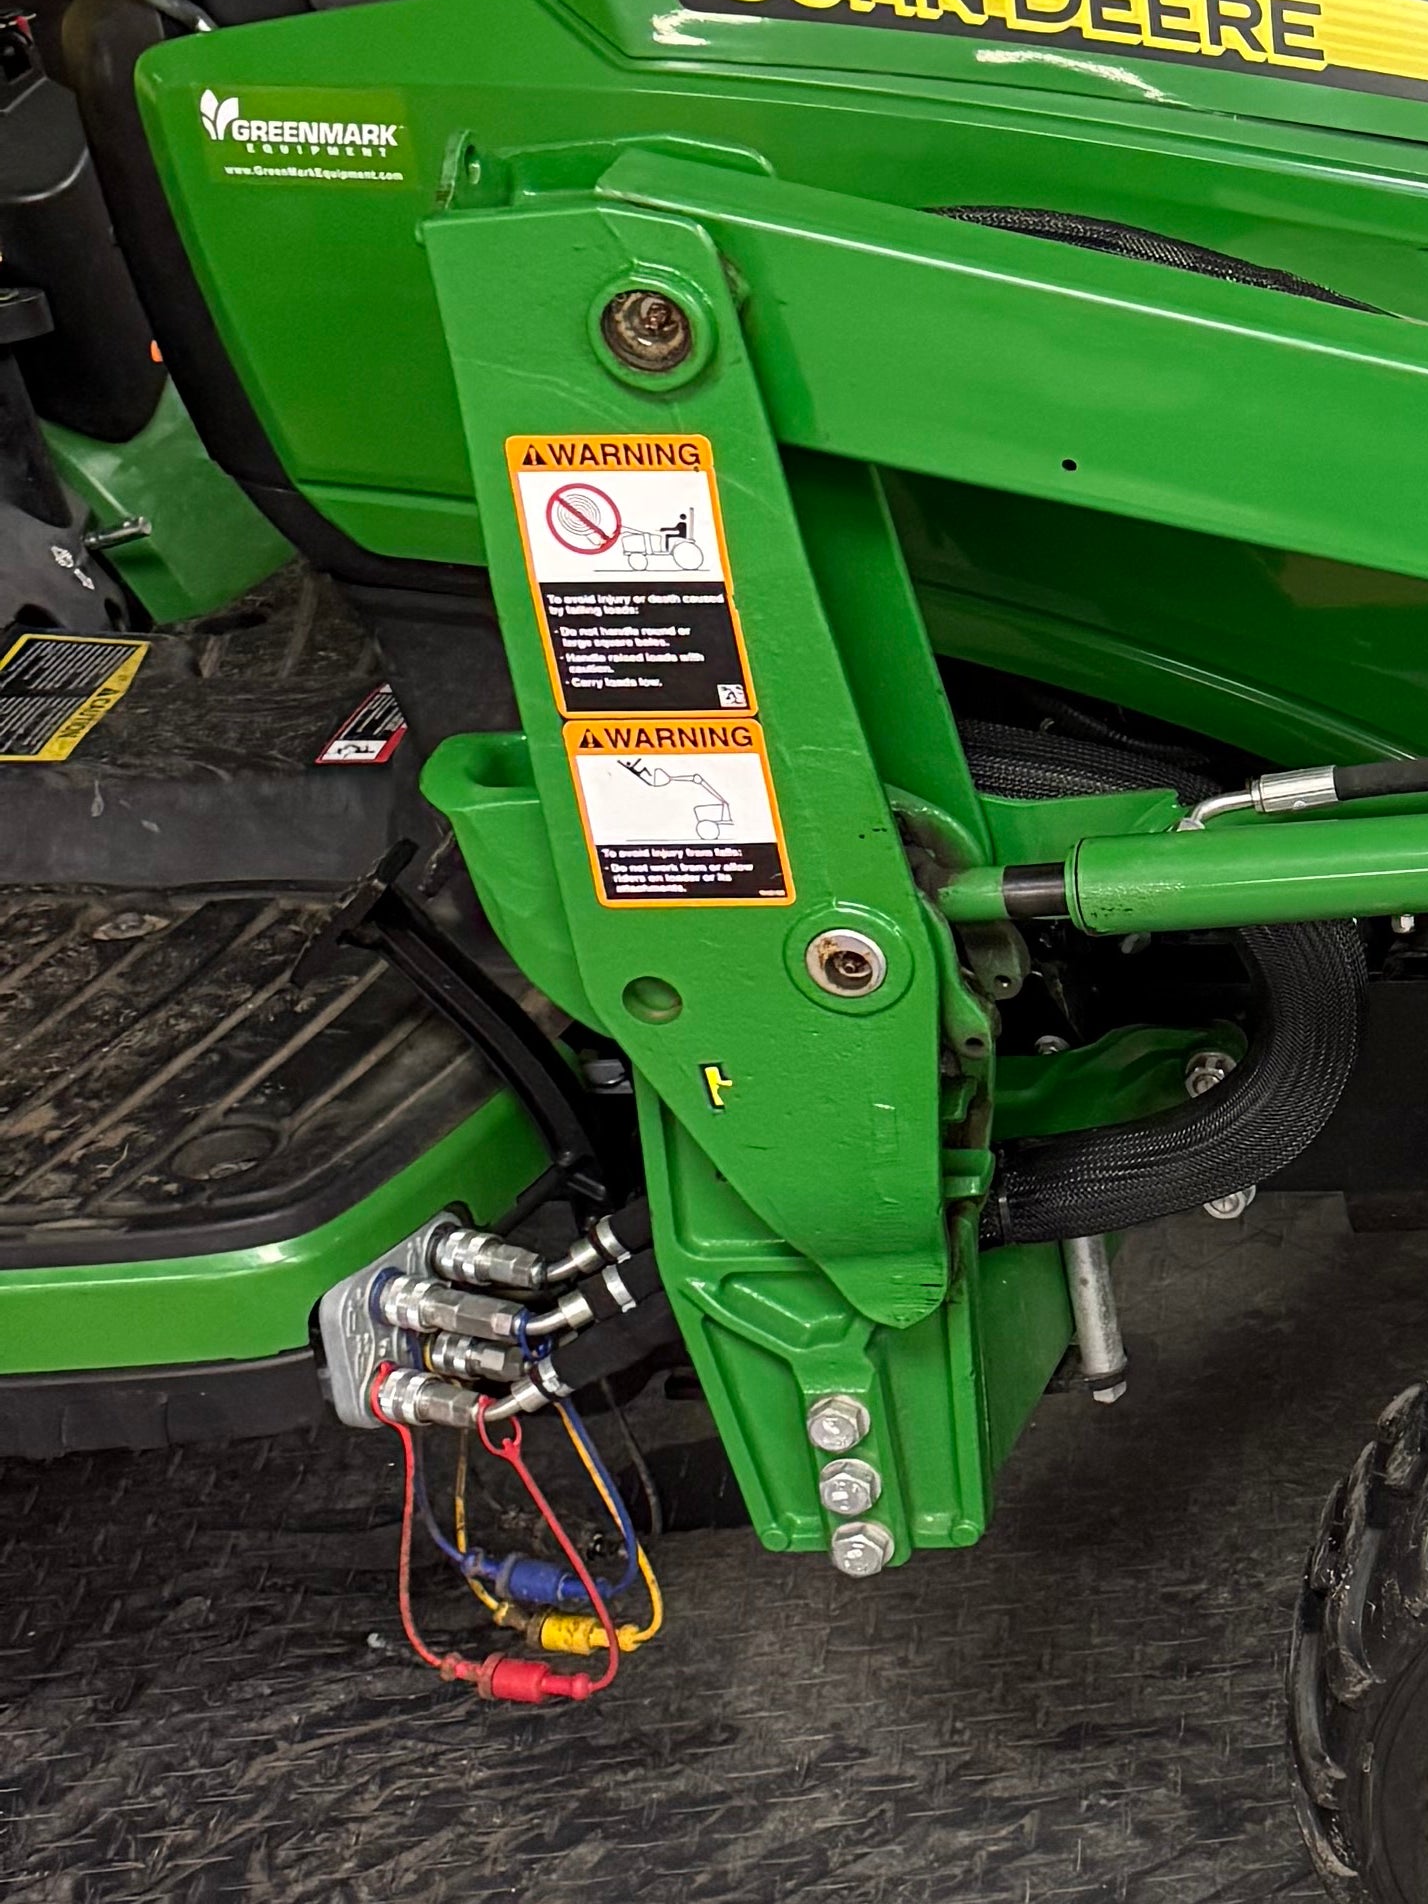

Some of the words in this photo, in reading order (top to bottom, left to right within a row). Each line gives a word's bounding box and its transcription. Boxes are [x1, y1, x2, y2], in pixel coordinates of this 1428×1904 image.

[231, 119, 398, 146] GREENMARK
[246, 143, 387, 157] EQUIPMENT
[224, 165, 403, 181] www.GreenMarkEquipment.com
[547, 442, 700, 466] WARNING
[604, 726, 754, 748] WARNING
